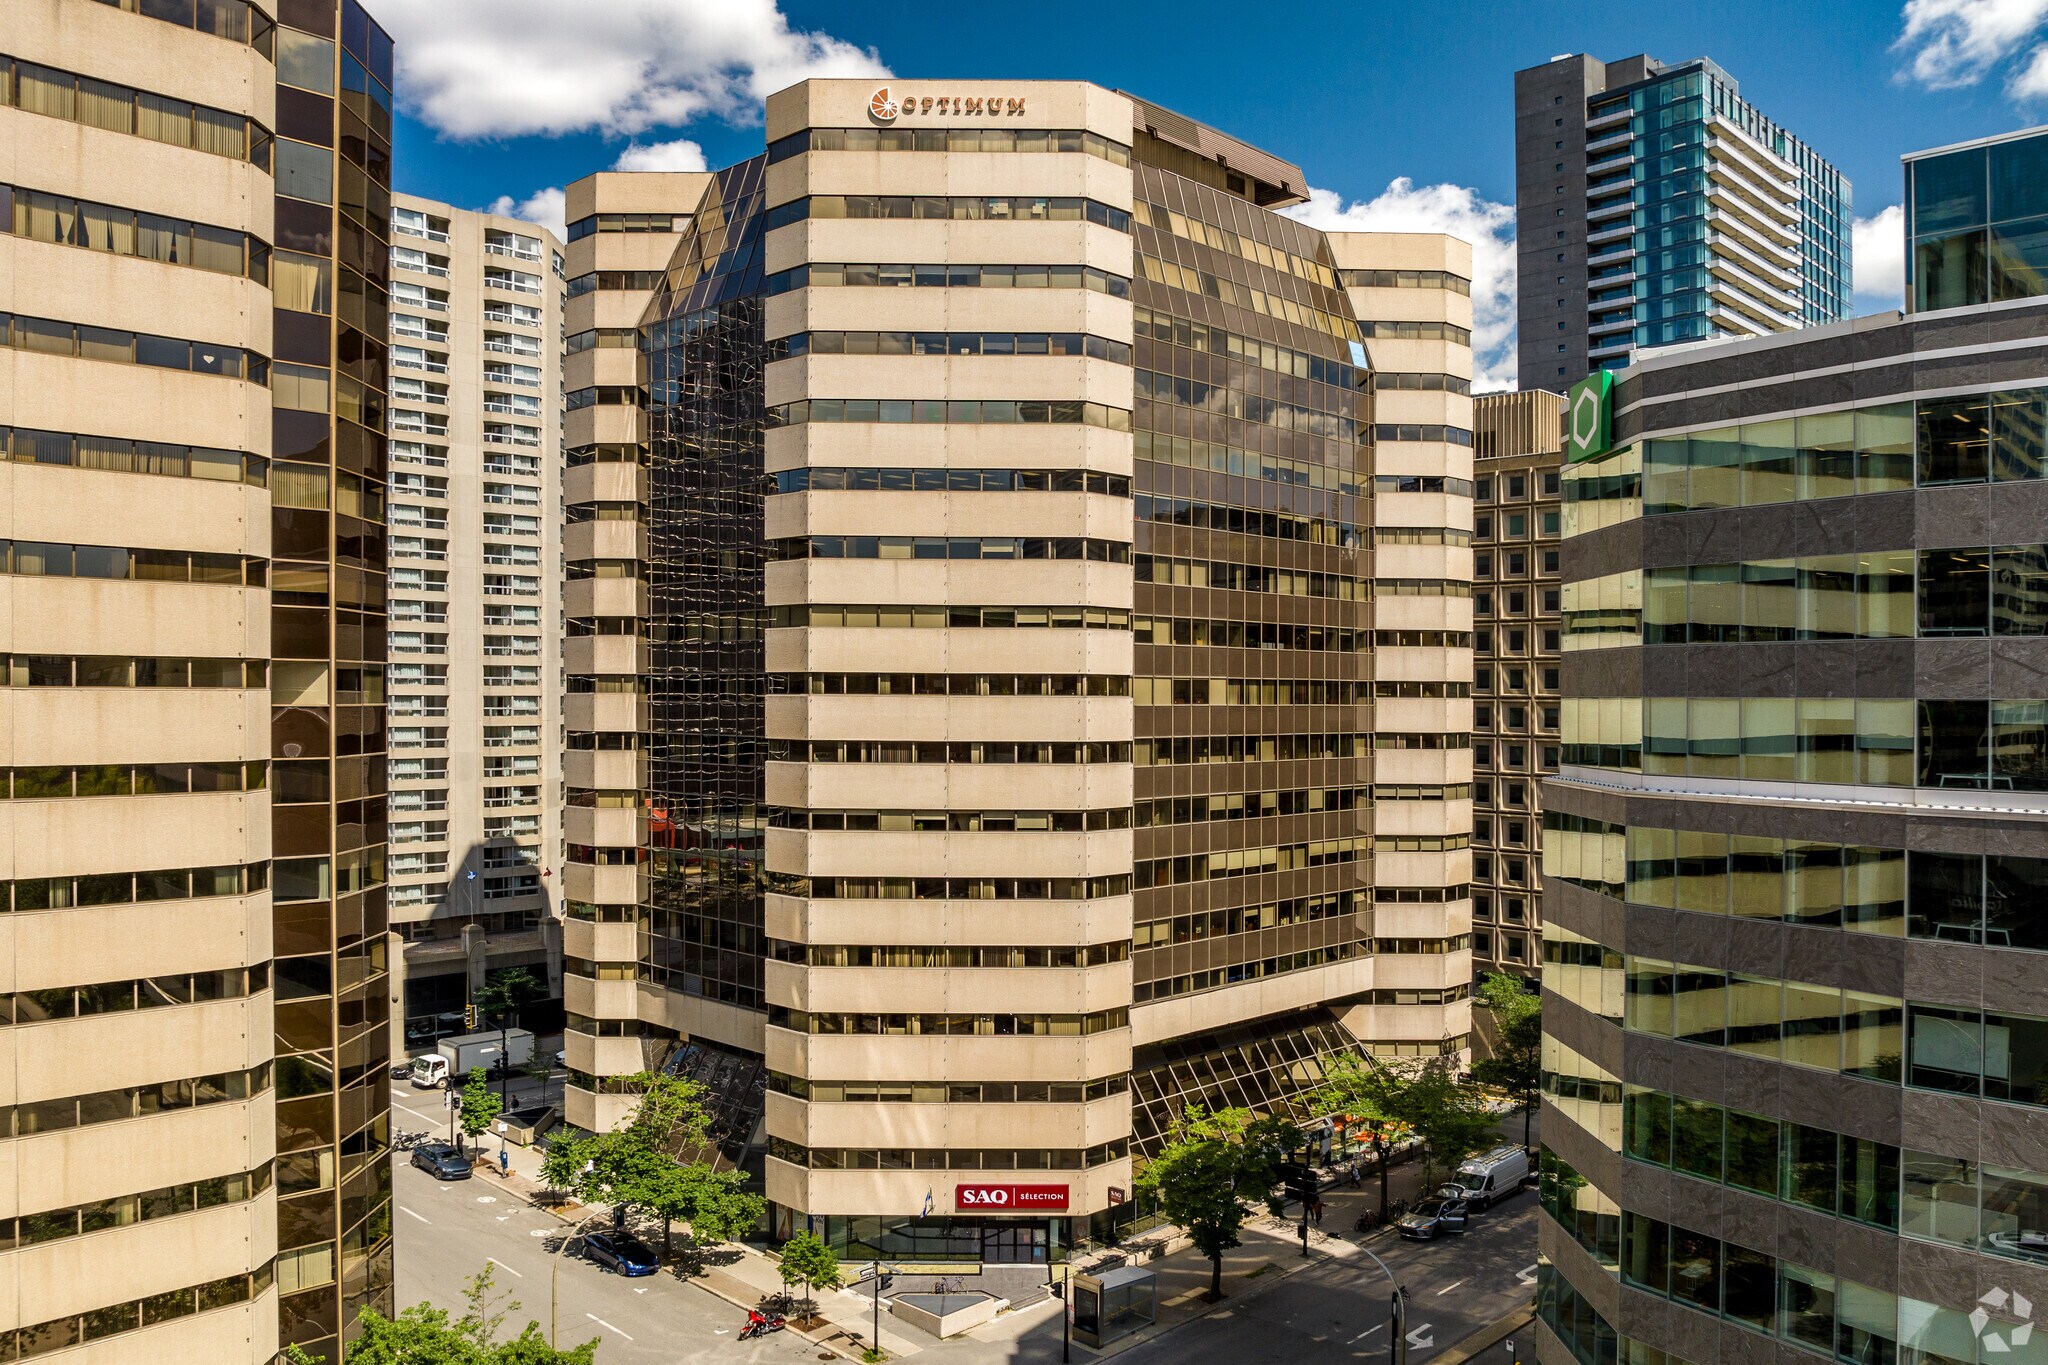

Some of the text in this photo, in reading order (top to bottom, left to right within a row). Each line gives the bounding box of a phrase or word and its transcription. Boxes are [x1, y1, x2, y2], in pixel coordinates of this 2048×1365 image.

[903, 96, 1026, 113] OPTIMUM
[963, 1189, 1064, 1205] SAQ SÉLECTION
